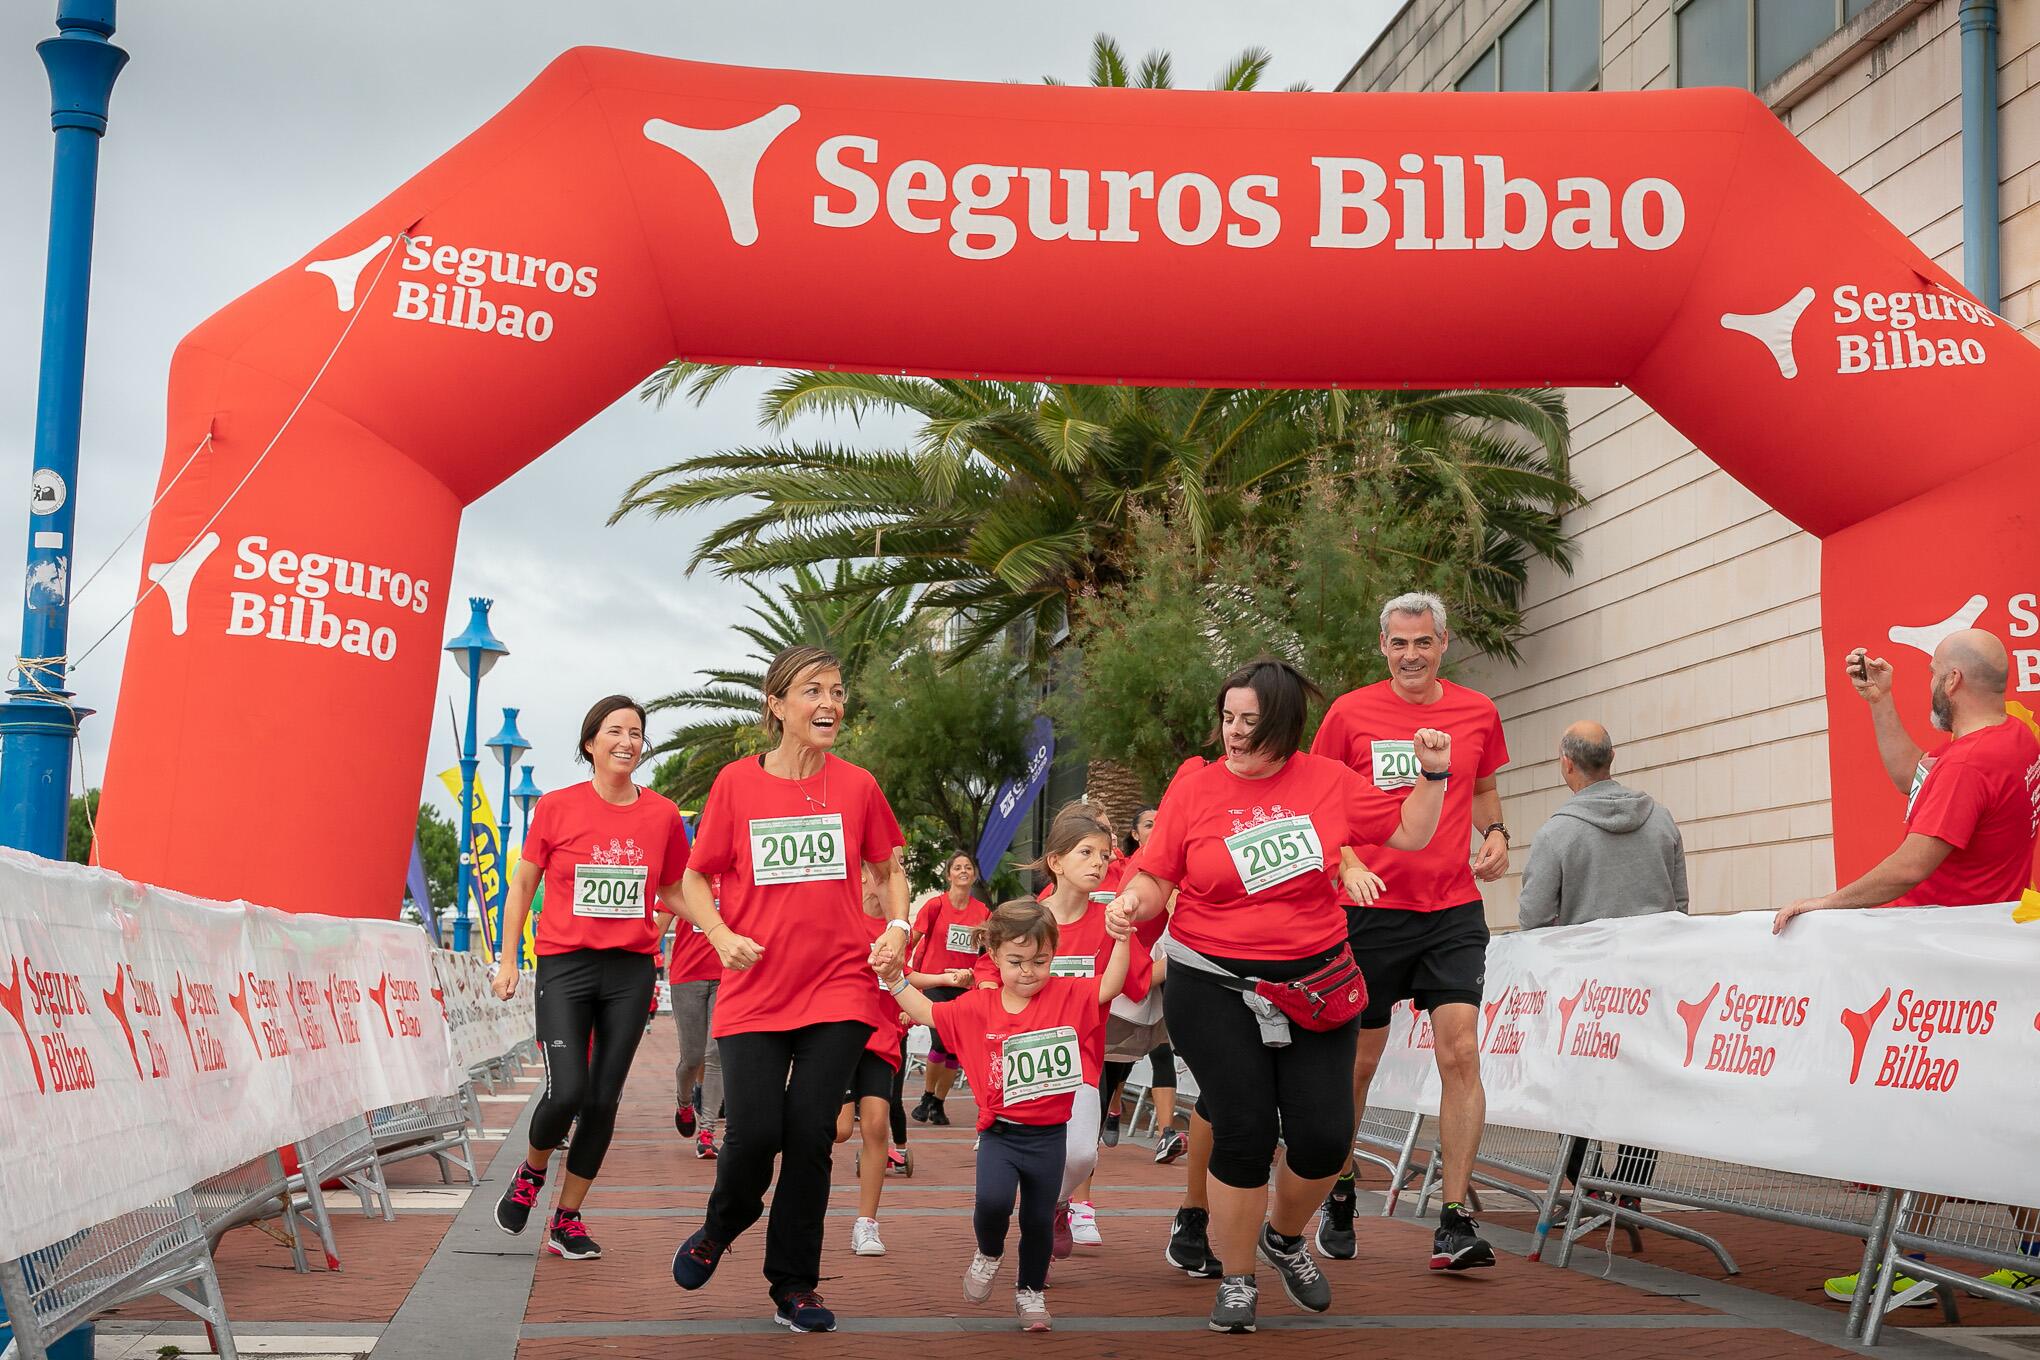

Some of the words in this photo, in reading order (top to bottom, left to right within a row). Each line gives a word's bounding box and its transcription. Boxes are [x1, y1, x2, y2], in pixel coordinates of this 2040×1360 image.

[813, 135, 1281, 260] Seguros
[1310, 153, 1685, 251] Bilbao
[402, 235, 598, 298] Seguros
[393, 280, 554, 342] Bilbao
[1833, 284, 1995, 327] Seguros
[1836, 330, 1986, 374] Bilbao
[233, 535, 430, 614] Seguros
[225, 591, 397, 661] Bilbao
[1381, 753, 1420, 777] 200
[762, 832, 835, 867] 2049
[1243, 831, 1314, 876] 2051
[582, 880, 639, 906] 2004
[951, 932, 973, 947] 200
[1504, 983, 1547, 1022] Seguros
[1583, 978, 1651, 1020] Seguros
[1719, 984, 1811, 1032] Seguros
[1892, 989, 1998, 1043] Seguros
[1490, 1022, 1526, 1055] Bilbao
[1570, 1022, 1621, 1060] Bilbao
[1704, 1033, 1776, 1077] Bilbao
[41, 1031, 95, 1093] Bilbao
[1007, 1045, 1072, 1087] 2049
[1874, 1044, 1959, 1093] Bilbao
